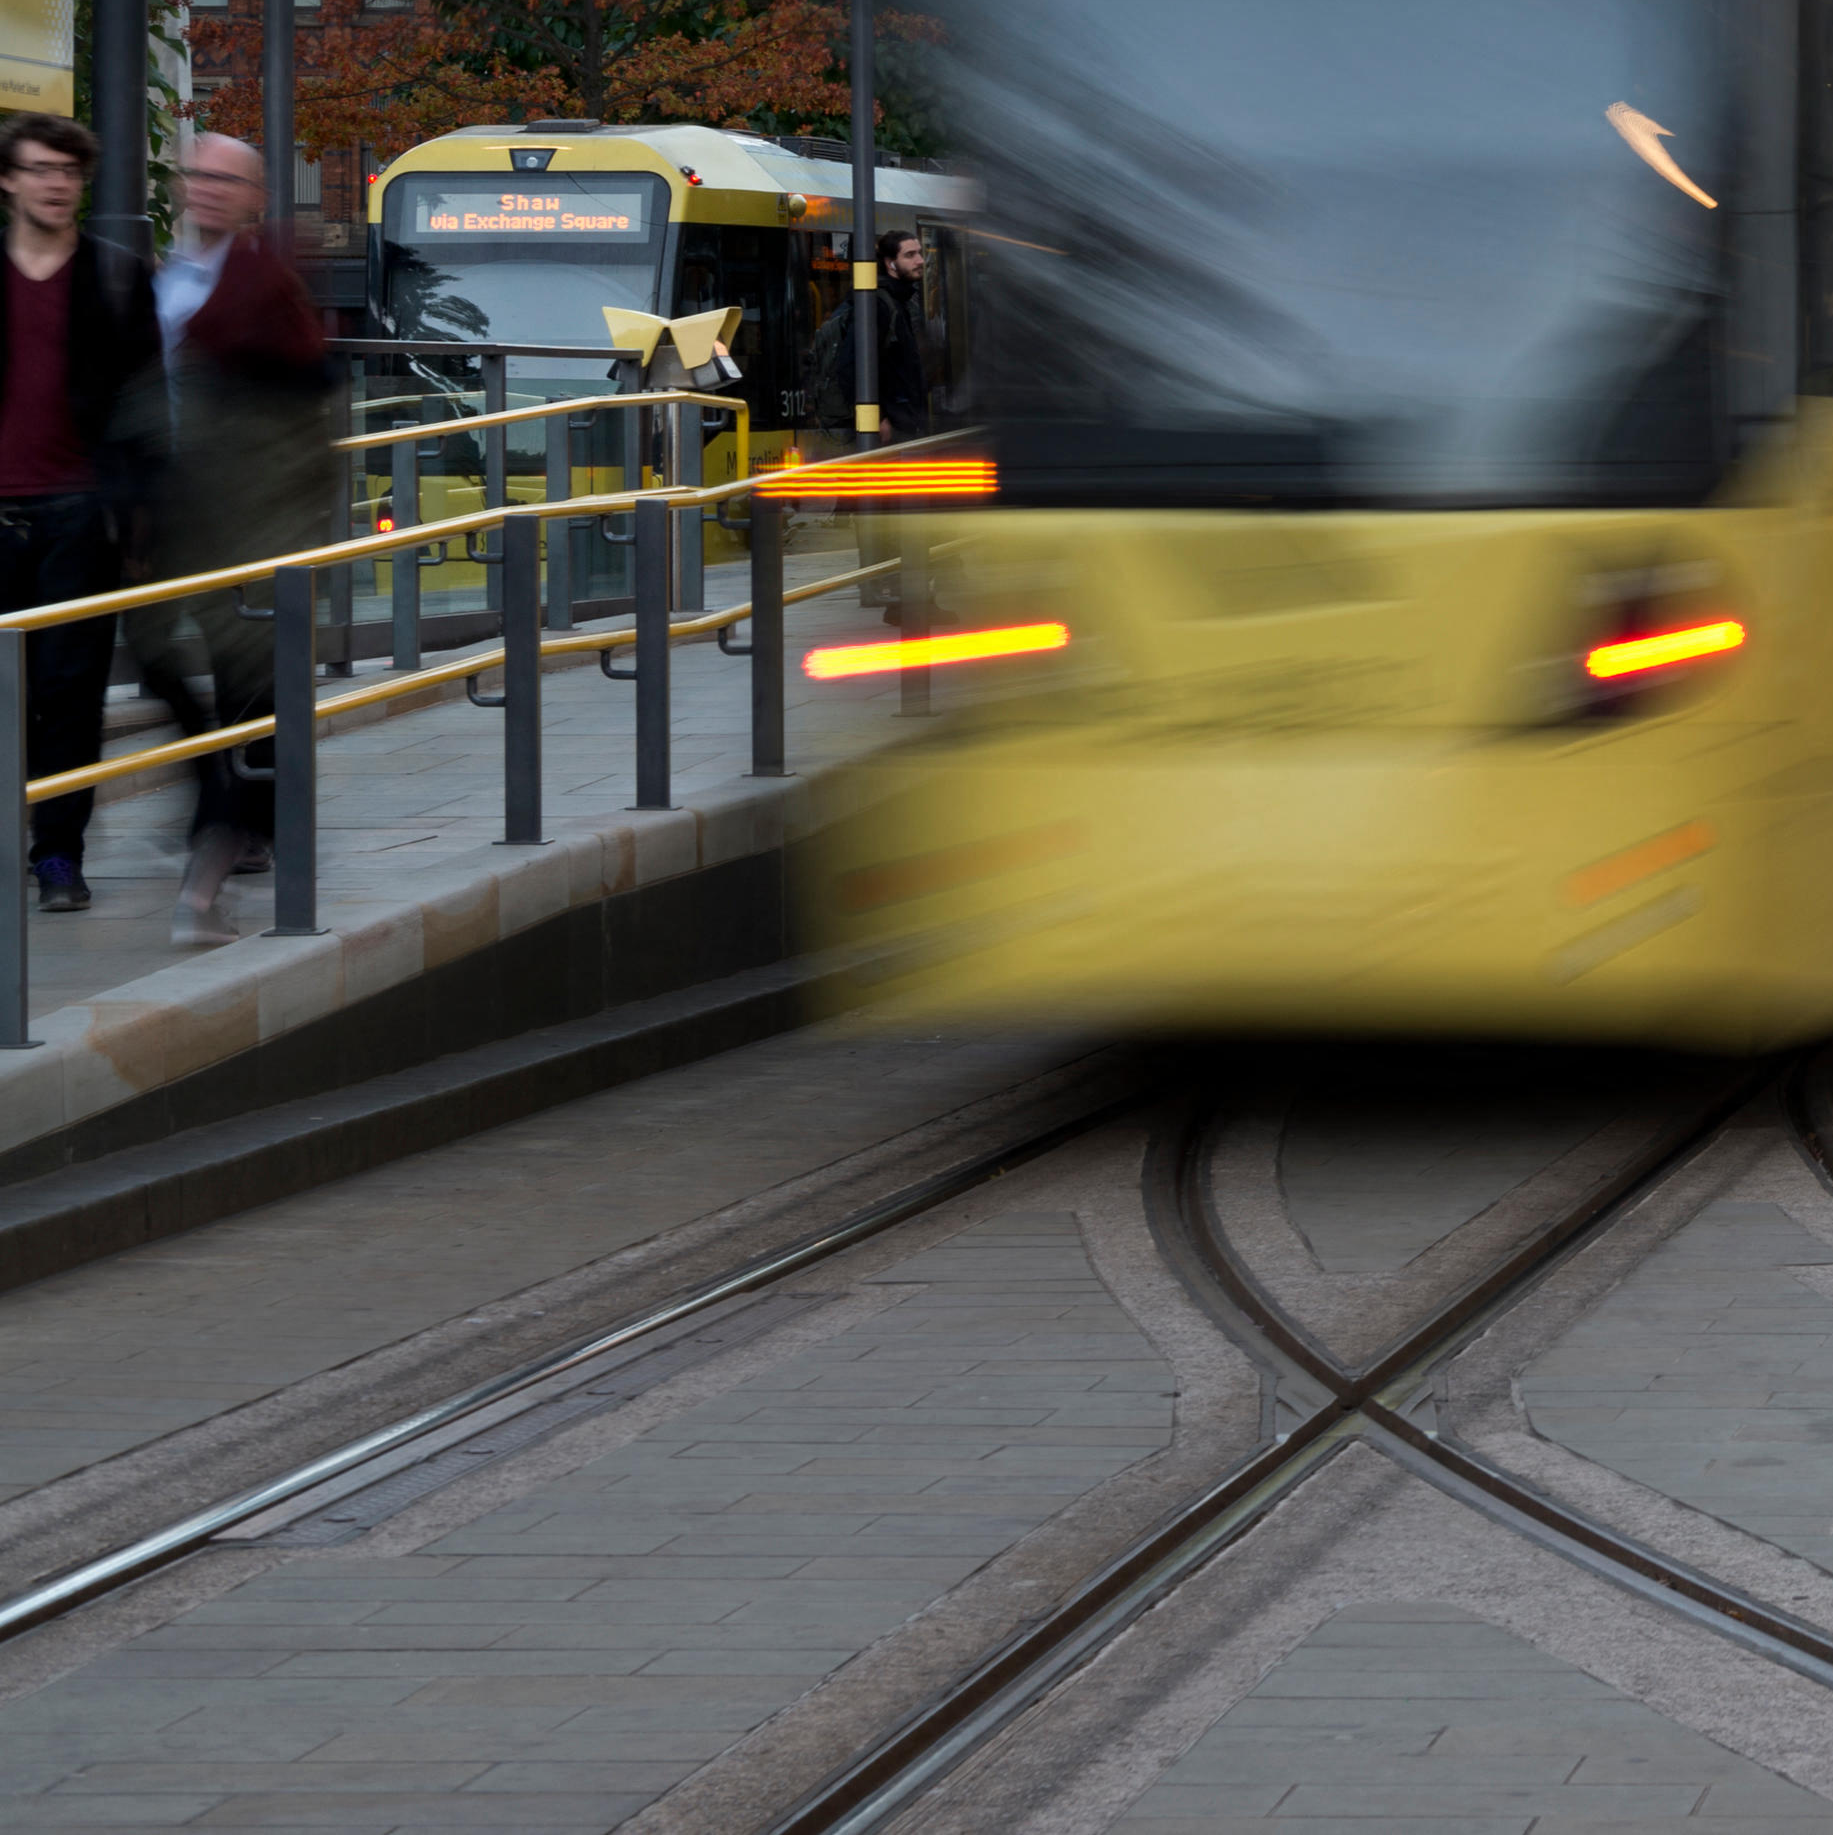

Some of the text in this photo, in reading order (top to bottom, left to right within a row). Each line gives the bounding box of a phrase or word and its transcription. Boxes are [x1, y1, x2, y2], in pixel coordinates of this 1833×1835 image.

[500, 194, 561, 211] Shaw
[430, 213, 630, 231] via Exchange Square
[780, 389, 807, 417] 3112
